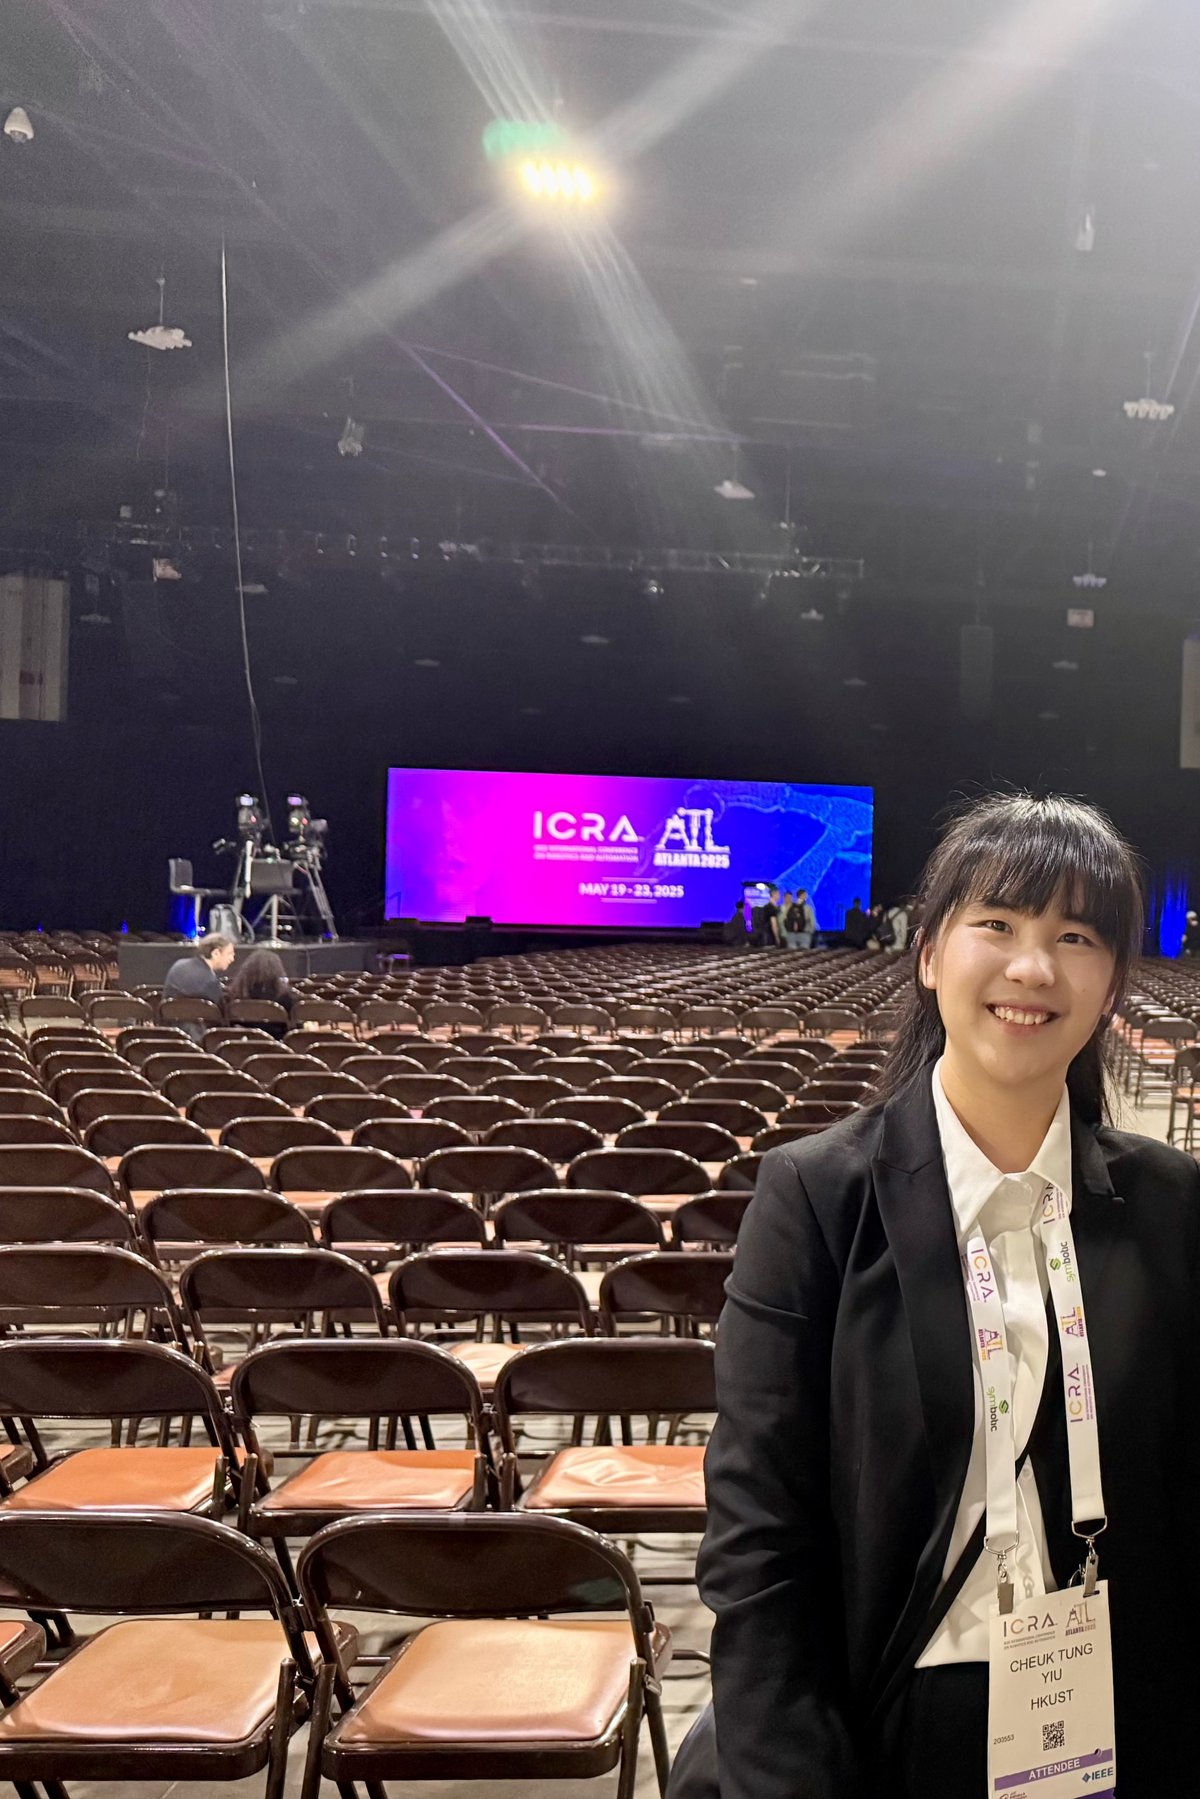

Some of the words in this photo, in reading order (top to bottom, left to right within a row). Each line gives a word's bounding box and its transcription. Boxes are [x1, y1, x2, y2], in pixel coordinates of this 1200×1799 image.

[533, 811, 639, 842] ICRA
[654, 807, 730, 852] ATL
[653, 852, 700, 868] ATLANTA
[700, 854, 730, 869] 2025
[578, 882, 609, 895] MAY
[610, 883, 627, 896] 19
[653, 885, 684, 898] 2025
[971, 1248, 995, 1302] ICRA
[1060, 1241, 1076, 1283] symbotic
[1068, 1364, 1083, 1423] ICRA
[986, 1386, 998, 1432] symbotic
[1003, 1612, 1057, 1638] ICRA
[1010, 1651, 1055, 1673] CHEUK
[1058, 1643, 1093, 1661] TUNG
[1041, 1668, 1063, 1685] YIU
[1030, 1689, 1074, 1710] HKUST
[1028, 1759, 1081, 1780] ATTENDEE
[1091, 1767, 1114, 1781] IEEE
